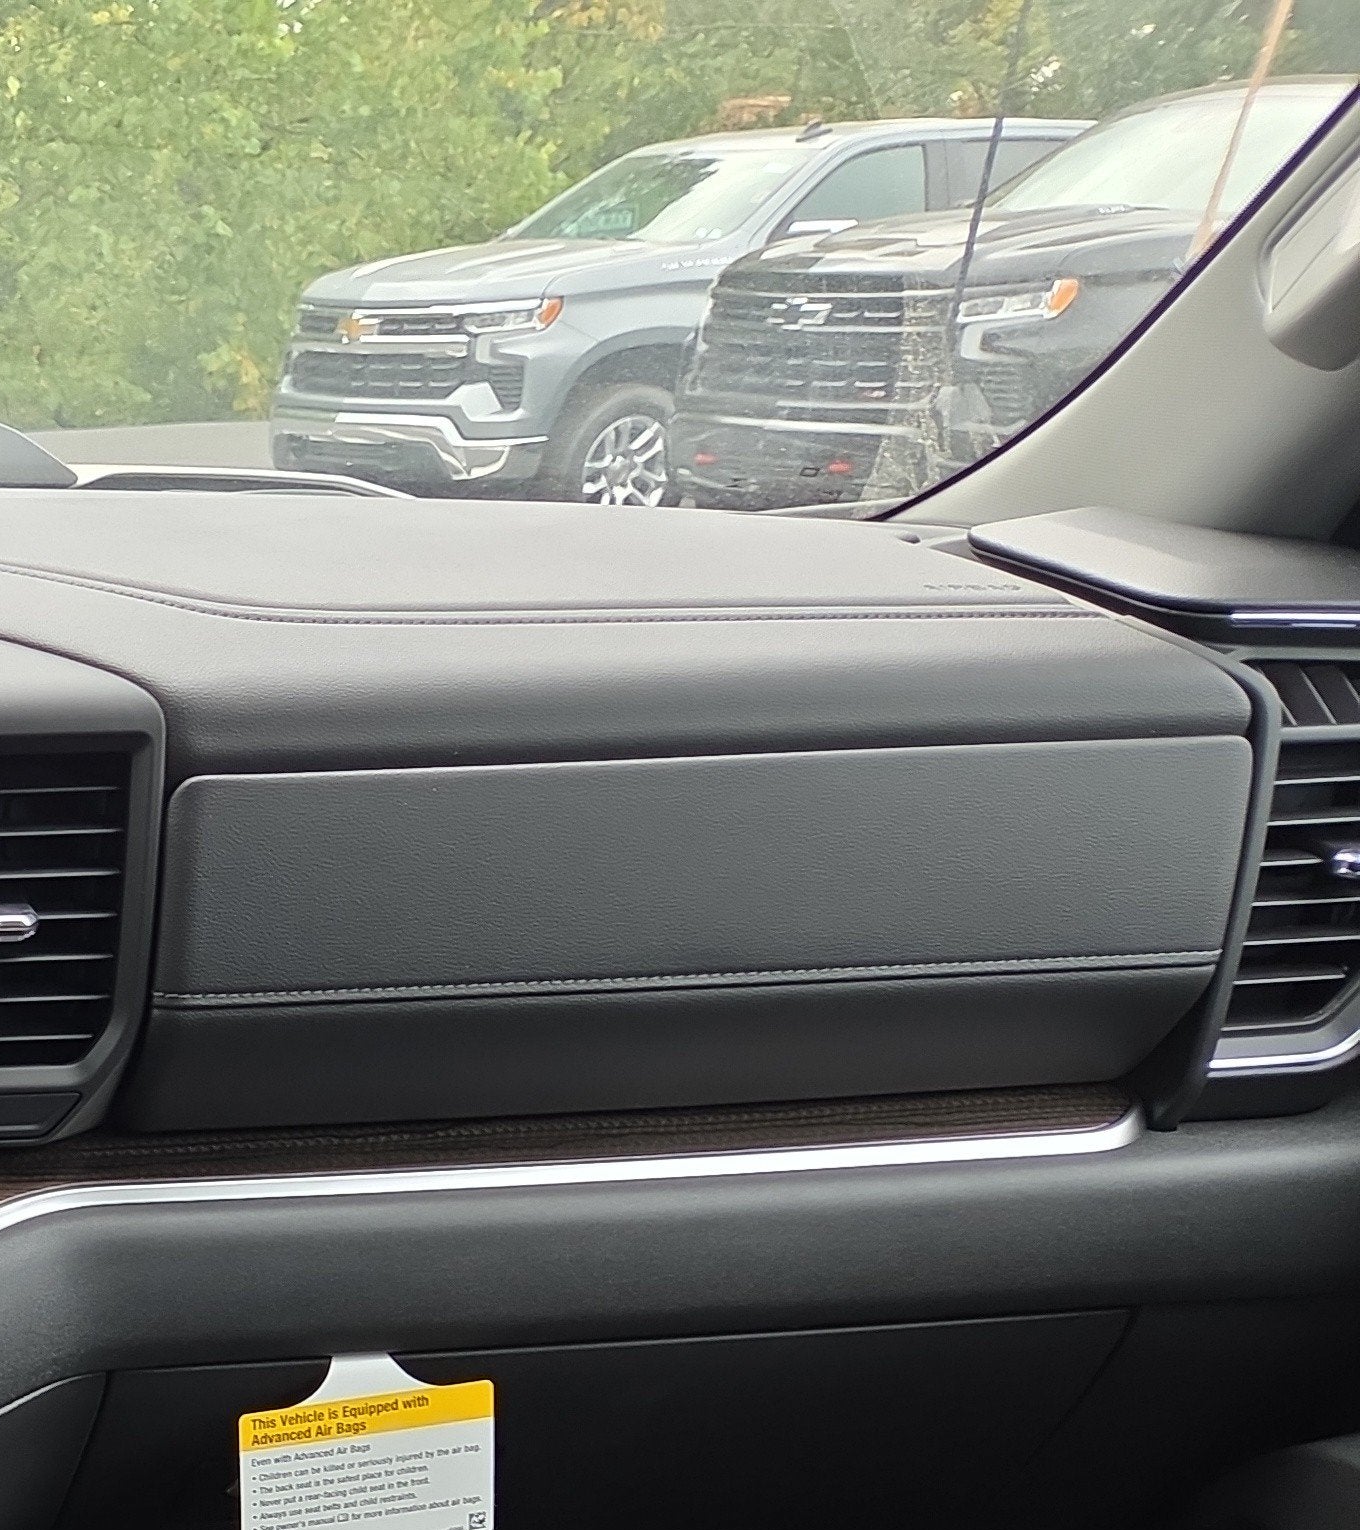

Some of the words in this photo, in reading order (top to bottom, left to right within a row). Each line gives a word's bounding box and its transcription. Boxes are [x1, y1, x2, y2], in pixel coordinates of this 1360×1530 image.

[251, 1416, 277, 1431] This
[280, 1409, 325, 1427] Vehicle
[327, 1406, 339, 1420] is
[342, 1397, 399, 1418] Equipped
[402, 1395, 429, 1409] with
[251, 1426, 312, 1447] Advanced
[315, 1424, 332, 1438] Air
[336, 1421, 367, 1435] Bags
[250, 1458, 272, 1467] Even
[273, 1454, 292, 1463] with
[294, 1449, 335, 1461] Advanced
[336, 1446, 349, 1455] Air
[350, 1444, 371, 1453] Bags
[259, 1471, 293, 1482] Children
[294, 1469, 309, 1477] can
[311, 1467, 321, 1475] be
[323, 1463, 346, 1472] killed
[346, 1462, 356, 1470] or
[357, 1457, 393, 1468] seriously
[395, 1452, 424, 1463] injured
[425, 1450, 435, 1459] by
[436, 1448, 450, 1456] the
[451, 1446, 462, 1454] air
[464, 1444, 481, 1453] bag.
[259, 1486, 273, 1494] The
[275, 1484, 294, 1492] back
[295, 1481, 312, 1490] seat
[313, 1479, 321, 1487] is
[322, 1478, 335, 1486] the
[337, 1474, 360, 1484] safest
[361, 1472, 383, 1481] place
[384, 1469, 395, 1477] for
[396, 1465, 429, 1475] children.
[259, 1499, 281, 1507] Never
[283, 1496, 297, 1505] put
[304, 1490, 347, 1500] rear-facing
[348, 1486, 368, 1495] child
[369, 1483, 386, 1492] seat
[410, 1477, 430, 1486] front.
[259, 1511, 287, 1520] Always
[304, 1506, 321, 1514] seat
[322, 1503, 341, 1511] belts
[343, 1500, 358, 1508] and
[359, 1497, 378, 1506] child
[379, 1493, 418, 1503] restraints.
[275, 1521, 306, 1530] owner's
[307, 1516, 335, 1526] manual
[363, 1510, 383, 1519] more
[384, 1504, 428, 1515] information
[428, 1499, 450, 1509] about
[462, 1495, 482, 1504] bags.
